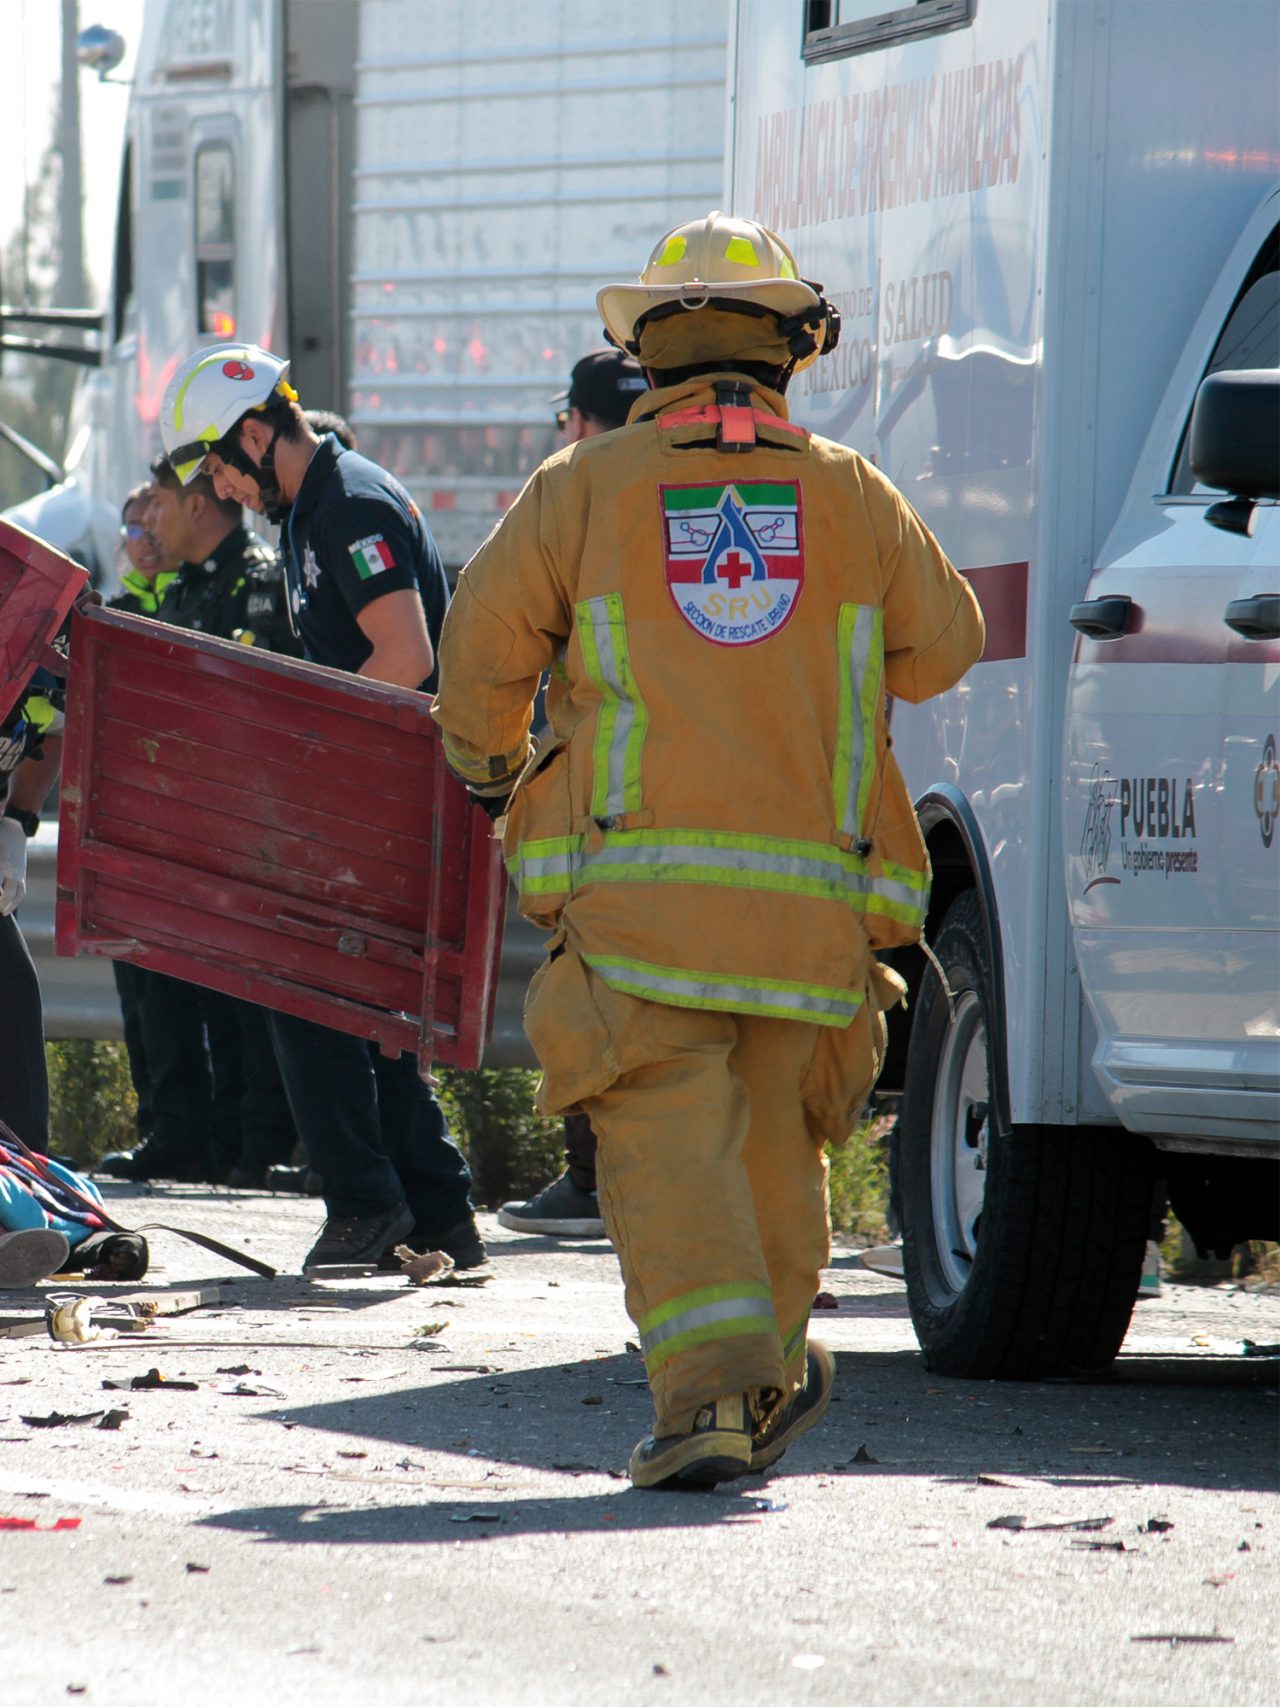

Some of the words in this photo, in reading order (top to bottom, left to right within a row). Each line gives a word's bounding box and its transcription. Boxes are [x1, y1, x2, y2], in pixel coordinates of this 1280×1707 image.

[884, 270, 953, 346] SALUD
[703, 585, 772, 621] SRU
[715, 624, 729, 639] DE
[728, 619, 768, 640] RESCATE
[765, 593, 791, 627] URBANO
[1121, 778, 1196, 838] PUEBLA
[1133, 842, 1165, 877] gobierno
[1165, 847, 1198, 880] presente
